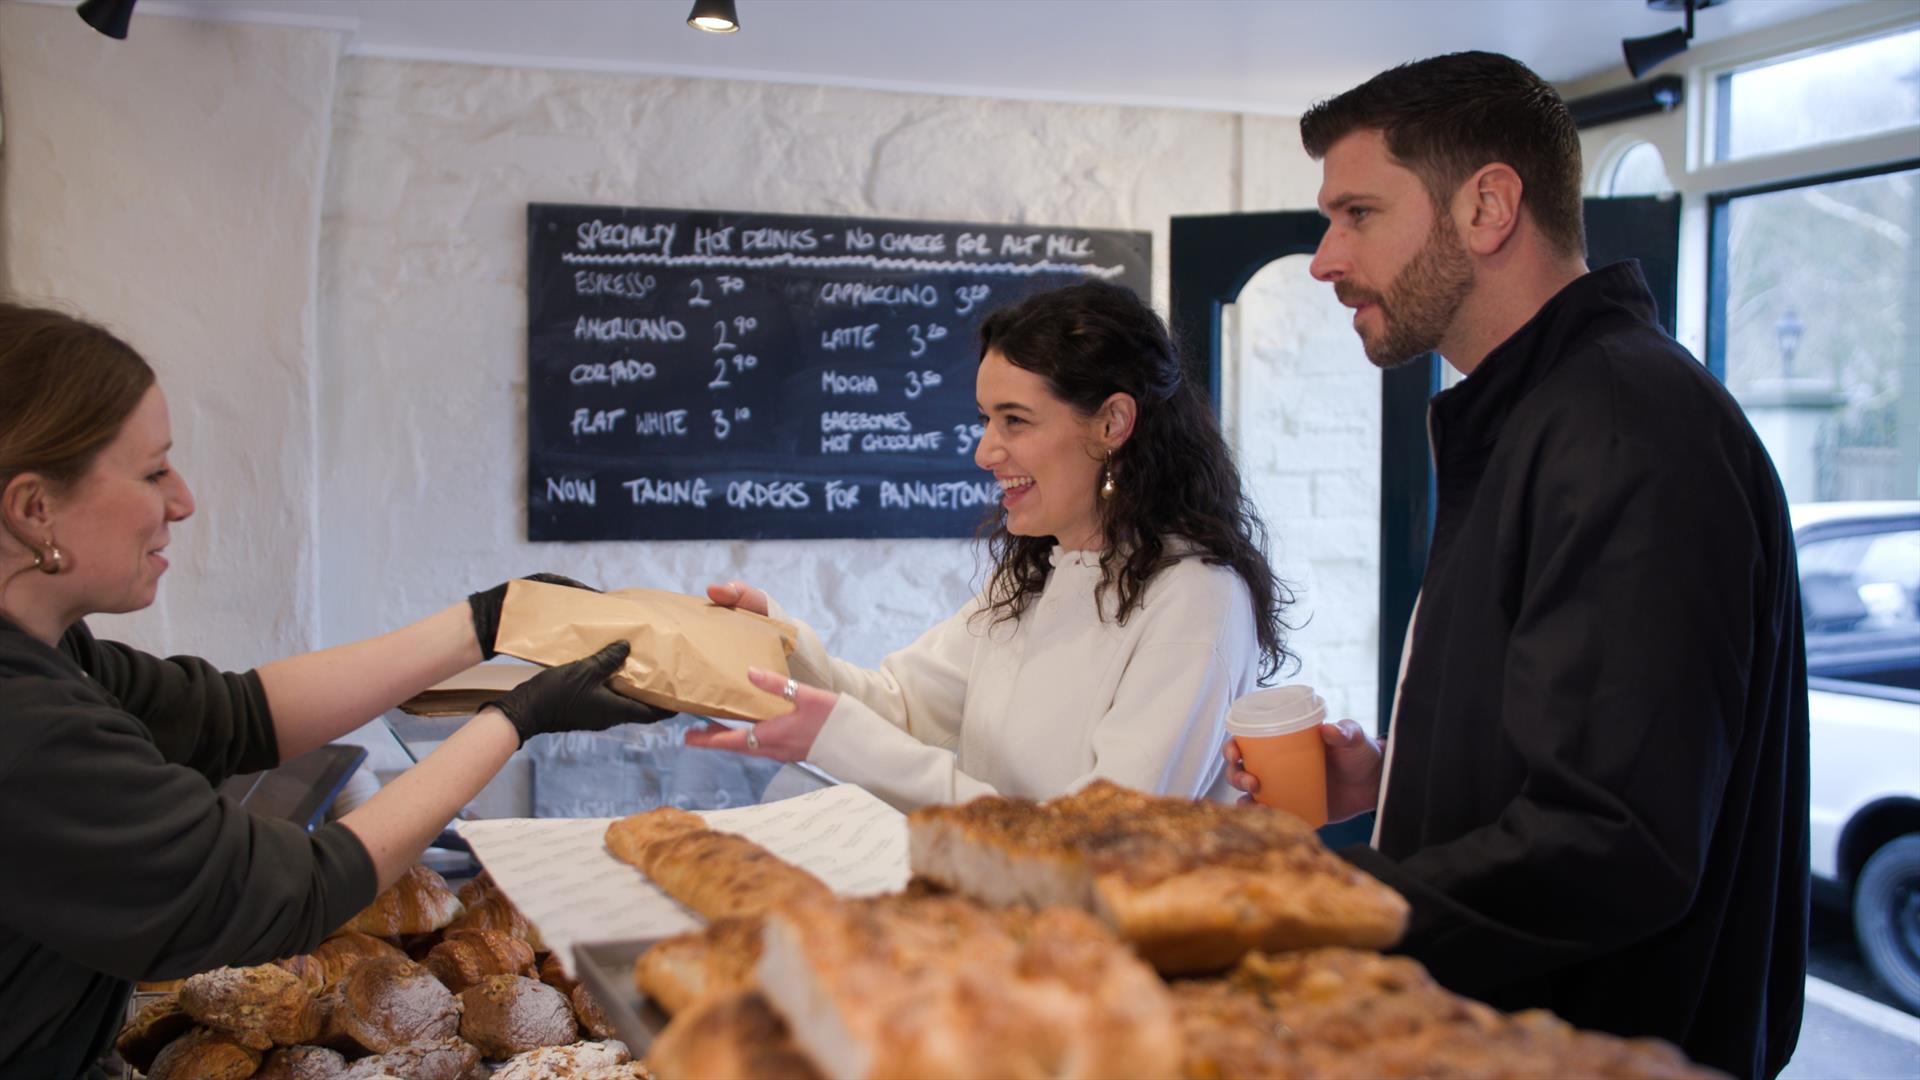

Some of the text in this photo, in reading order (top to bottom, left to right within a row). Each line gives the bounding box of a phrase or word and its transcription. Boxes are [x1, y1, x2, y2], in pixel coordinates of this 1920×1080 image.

[576, 219, 676, 255] SPECIALTY
[694, 226, 734, 256] HOT
[741, 228, 817, 250] DRINKS
[846, 227, 874, 250] NO
[880, 233, 947, 253] CHARGE
[956, 233, 992, 256] FOR
[1000, 235, 1042, 255] ALT
[574, 270, 656, 298] ESPRESSO
[820, 281, 938, 306] CAPPUCCINO
[574, 316, 686, 342] AMERICANO
[820, 323, 879, 350] LATTE
[570, 358, 656, 387] CORTADO
[821, 370, 879, 395] MOCHA
[570, 408, 626, 436] FLAT
[636, 410, 688, 436] WHITE
[821, 410, 912, 432] BAREBONES
[821, 434, 852, 453] HOT
[860, 431, 944, 451] CHOCOLATE
[547, 477, 596, 506] NOW
[623, 478, 712, 507] TAKING
[727, 480, 809, 508] ORDERS
[825, 480, 860, 512] FOR
